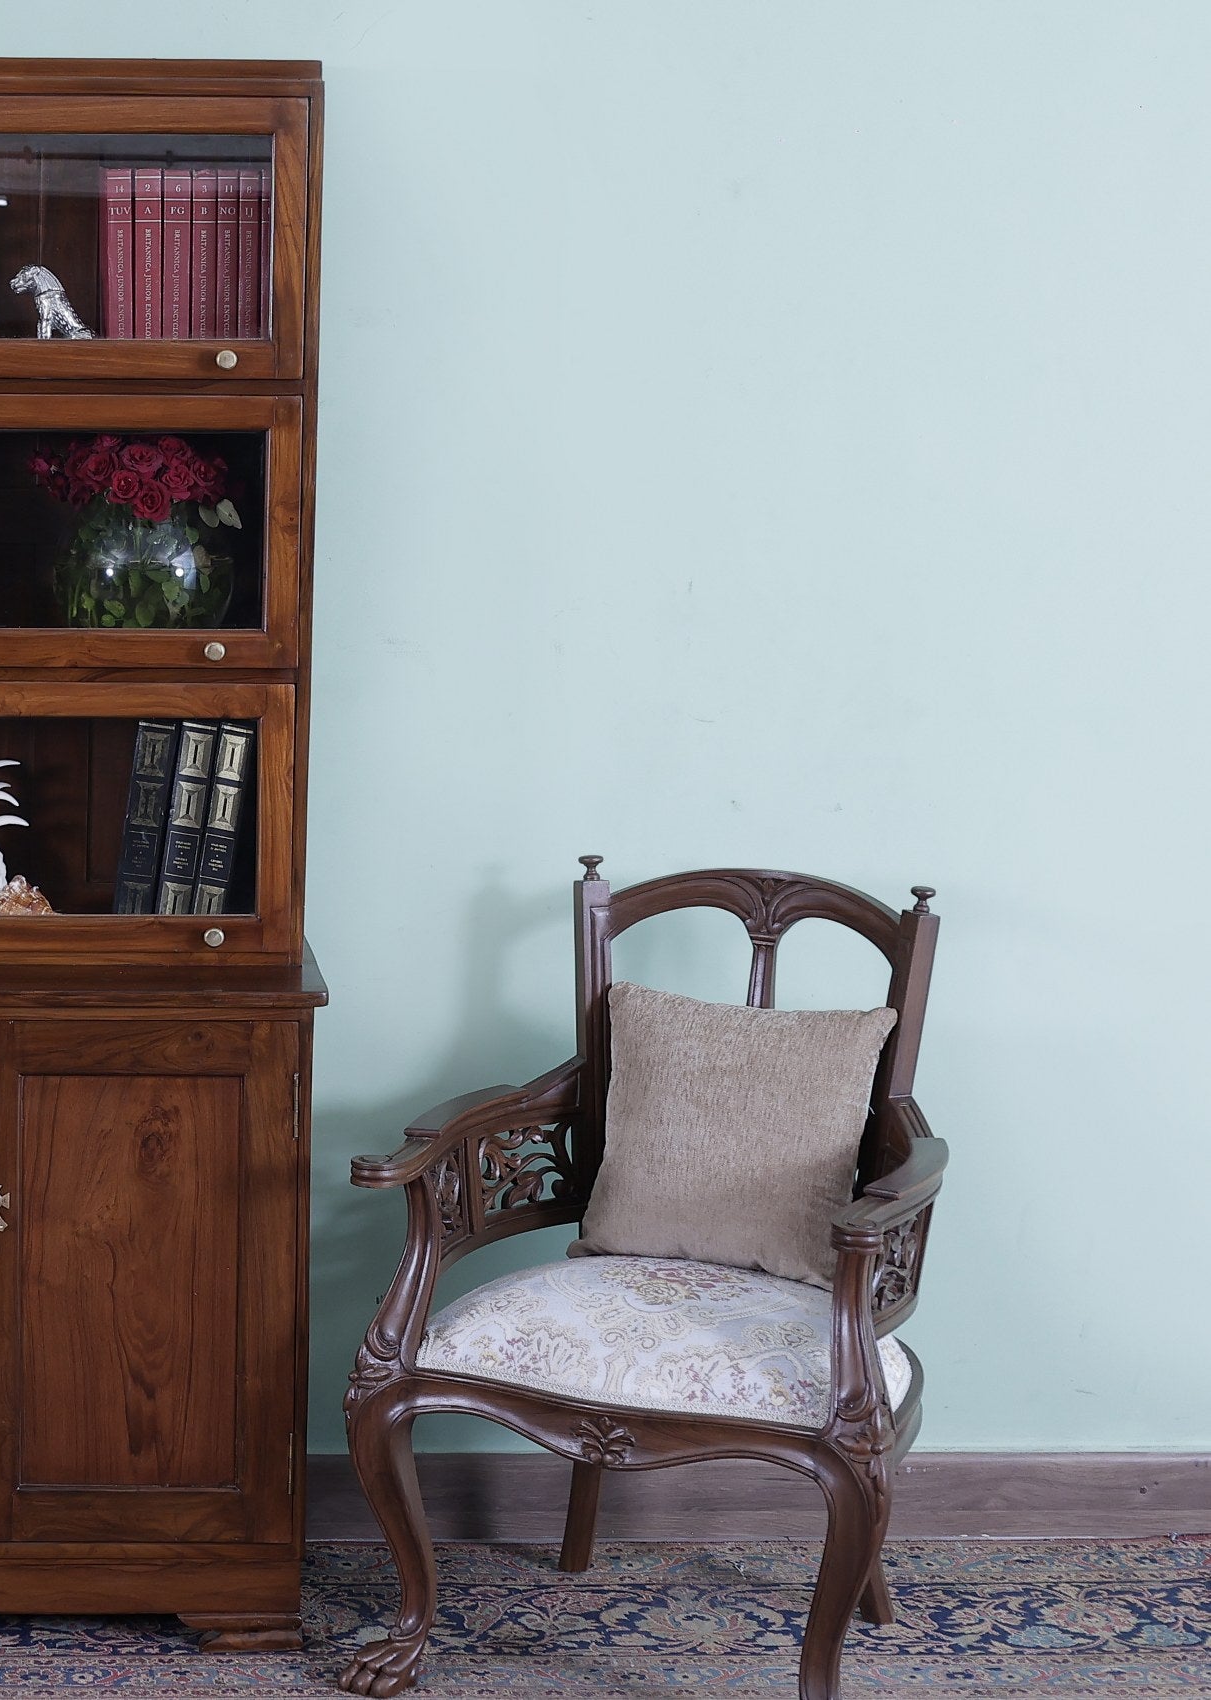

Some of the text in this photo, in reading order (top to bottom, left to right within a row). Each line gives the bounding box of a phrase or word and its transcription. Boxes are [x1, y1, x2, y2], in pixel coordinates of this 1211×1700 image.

[115, 185, 124, 193] 14
[144, 184, 151, 192] 2
[175, 184, 181, 192] 6
[202, 185, 208, 193] 3
[108, 207, 131, 216] TUV
[144, 206, 152, 214] A
[170, 207, 185, 215] FG
[201, 207, 207, 215] B
[219, 207, 236, 215] NO
[116, 274, 124, 302] JUNIOR
[144, 274, 152, 302] JUNIOR
[172, 274, 180, 302] JUNIOR
